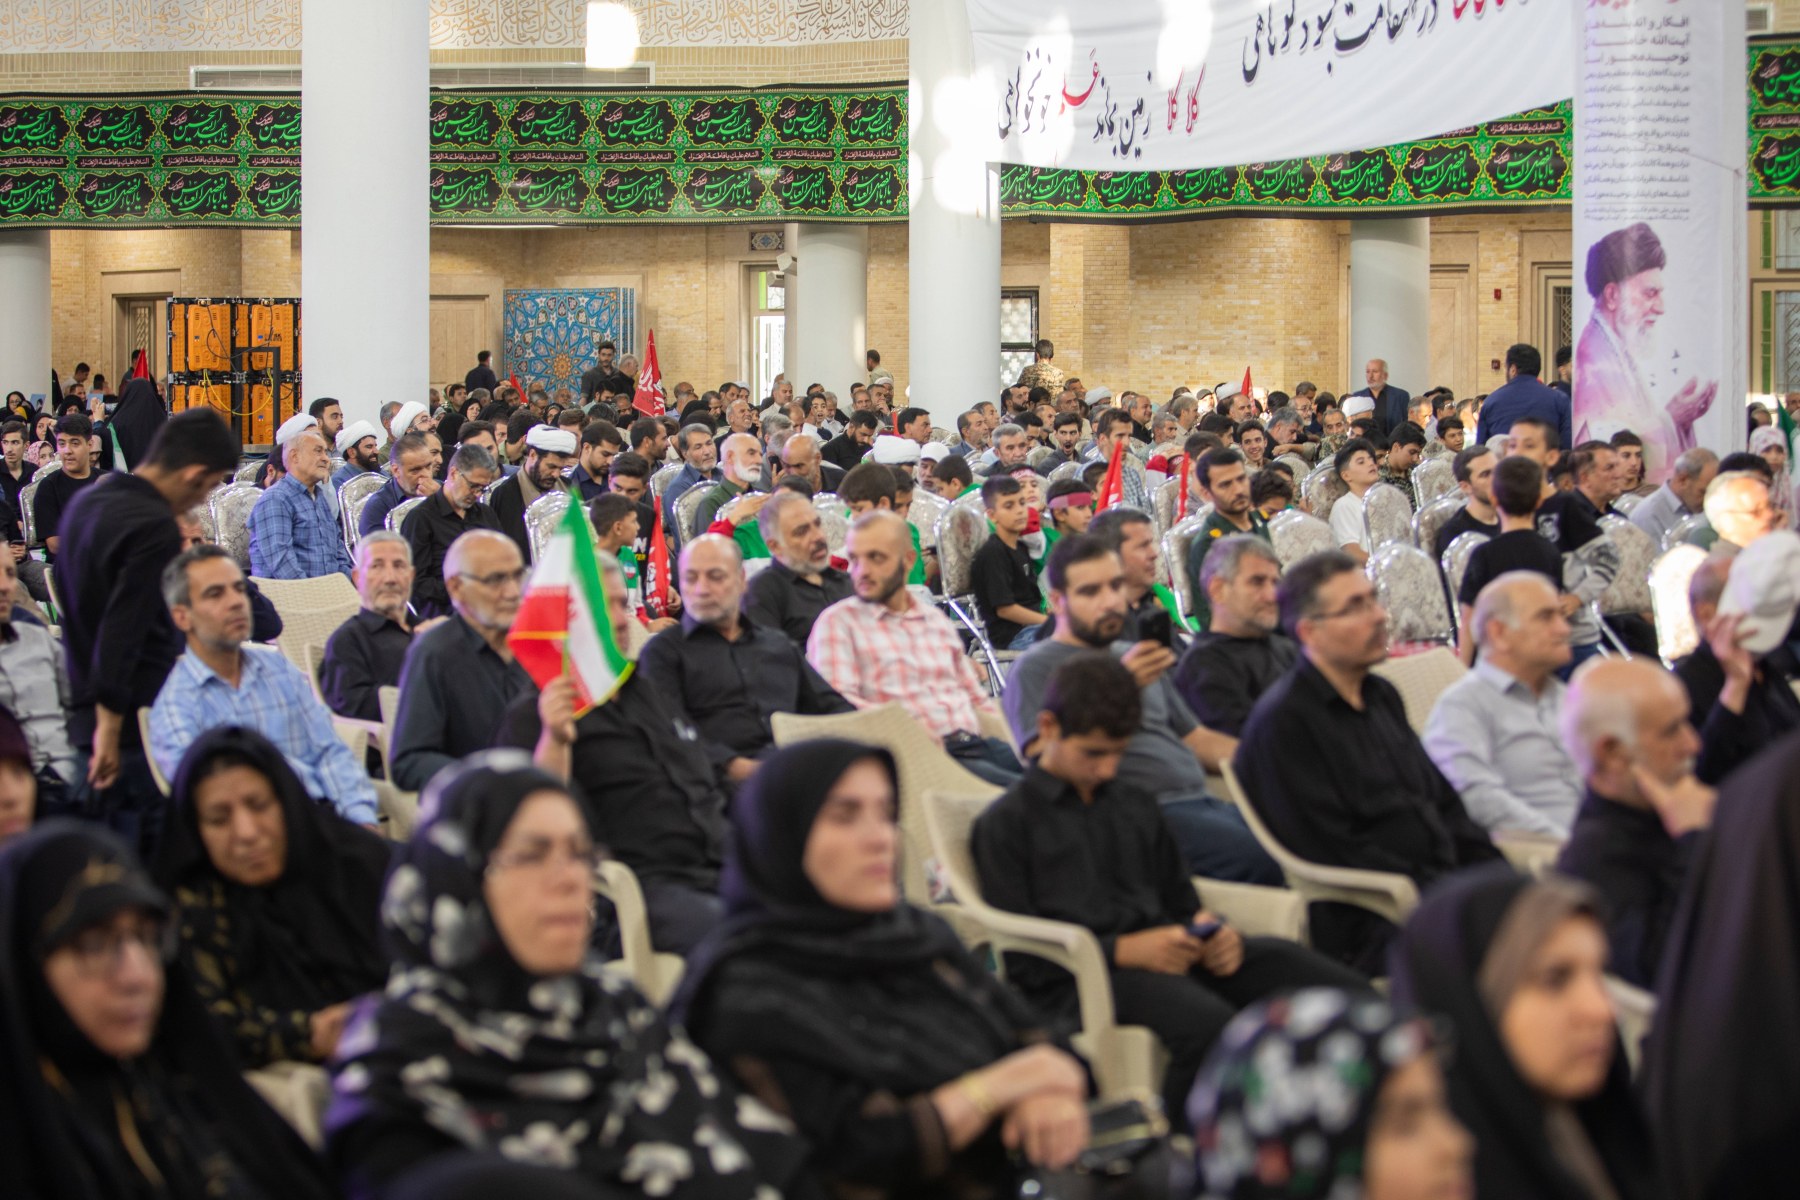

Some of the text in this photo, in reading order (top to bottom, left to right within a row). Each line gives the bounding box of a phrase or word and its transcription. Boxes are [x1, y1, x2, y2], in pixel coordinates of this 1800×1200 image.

[2, 110, 52, 144] الحسین
[88, 111, 136, 144] الحسین
[174, 108, 222, 142] الحسین
[433, 106, 484, 138] الحسین
[521, 105, 571, 138] الحسین
[609, 105, 659, 138] الحسین
[696, 104, 746, 138] الحسین
[783, 102, 822, 136] الحسین
[851, 102, 888, 135] الحسین
[1331, 159, 1368, 189] العباس
[1412, 155, 1451, 185] العباس
[1496, 151, 1537, 181] العباس
[0, 180, 39, 207] العباس
[85, 180, 125, 207] العباس
[171, 178, 211, 206] العباس
[257, 180, 298, 207] العباس
[431, 176, 472, 203] العباس
[518, 176, 559, 203] العباس
[606, 176, 647, 203] العباس
[694, 174, 735, 202] العباس
[782, 173, 813, 201] العباس
[848, 174, 879, 202] العباس
